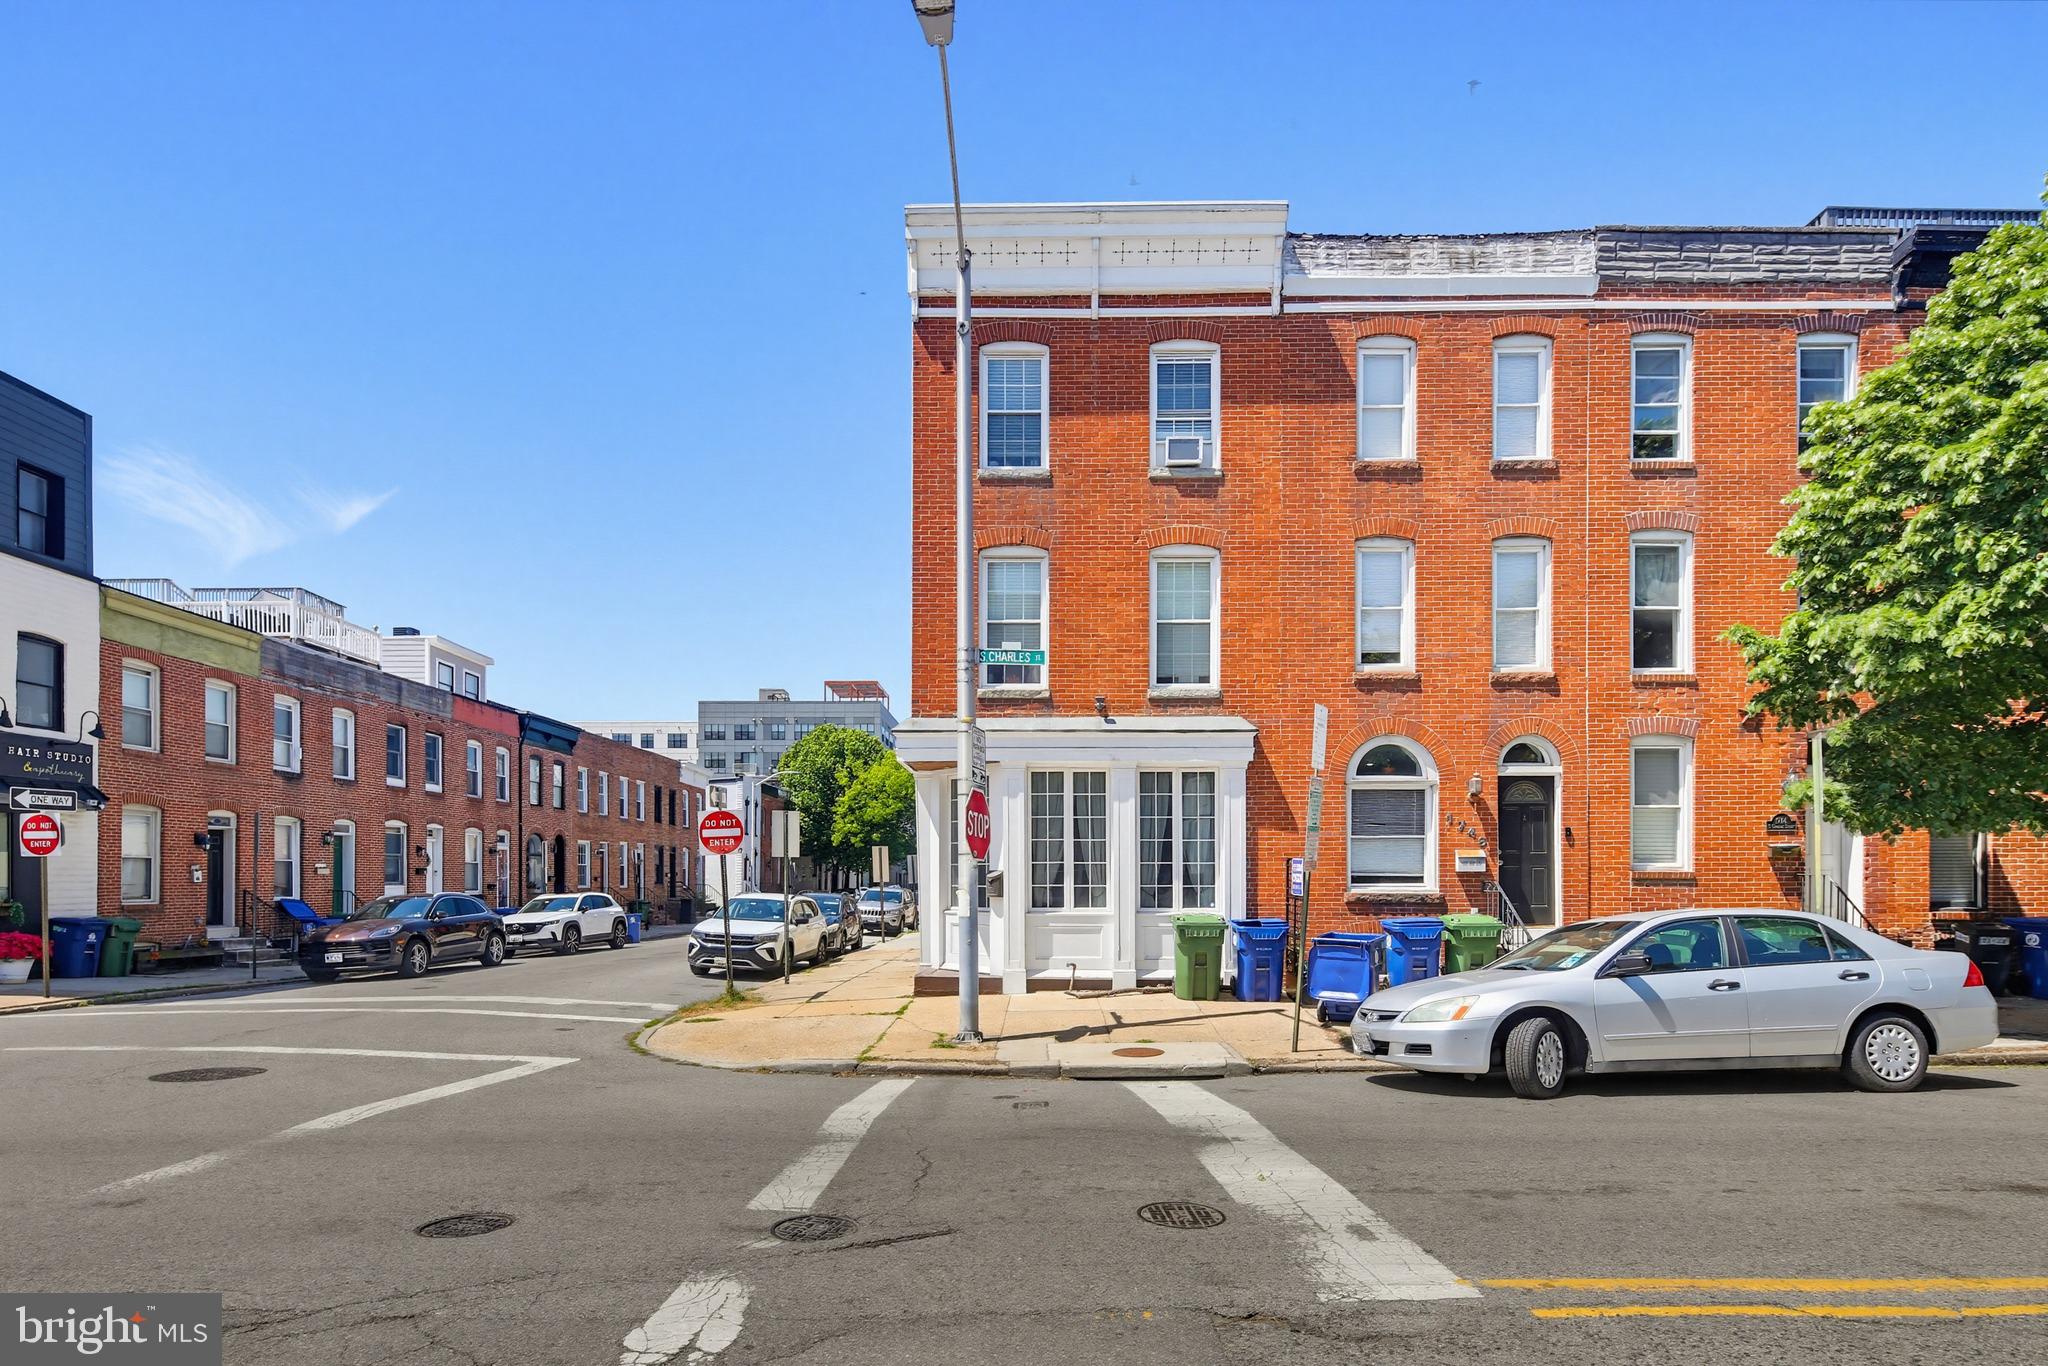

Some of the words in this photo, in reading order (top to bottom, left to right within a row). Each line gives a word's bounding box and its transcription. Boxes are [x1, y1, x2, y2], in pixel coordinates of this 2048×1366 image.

[988, 651, 1031, 663] CHARLES
[8, 746, 40, 758] HAIR
[47, 751, 91, 764] STUDIO
[30, 795, 49, 804] ONE
[52, 796, 70, 805] WAY
[719, 819, 737, 827] NOT
[967, 810, 990, 838] STOP
[709, 838, 735, 847] ENTER
